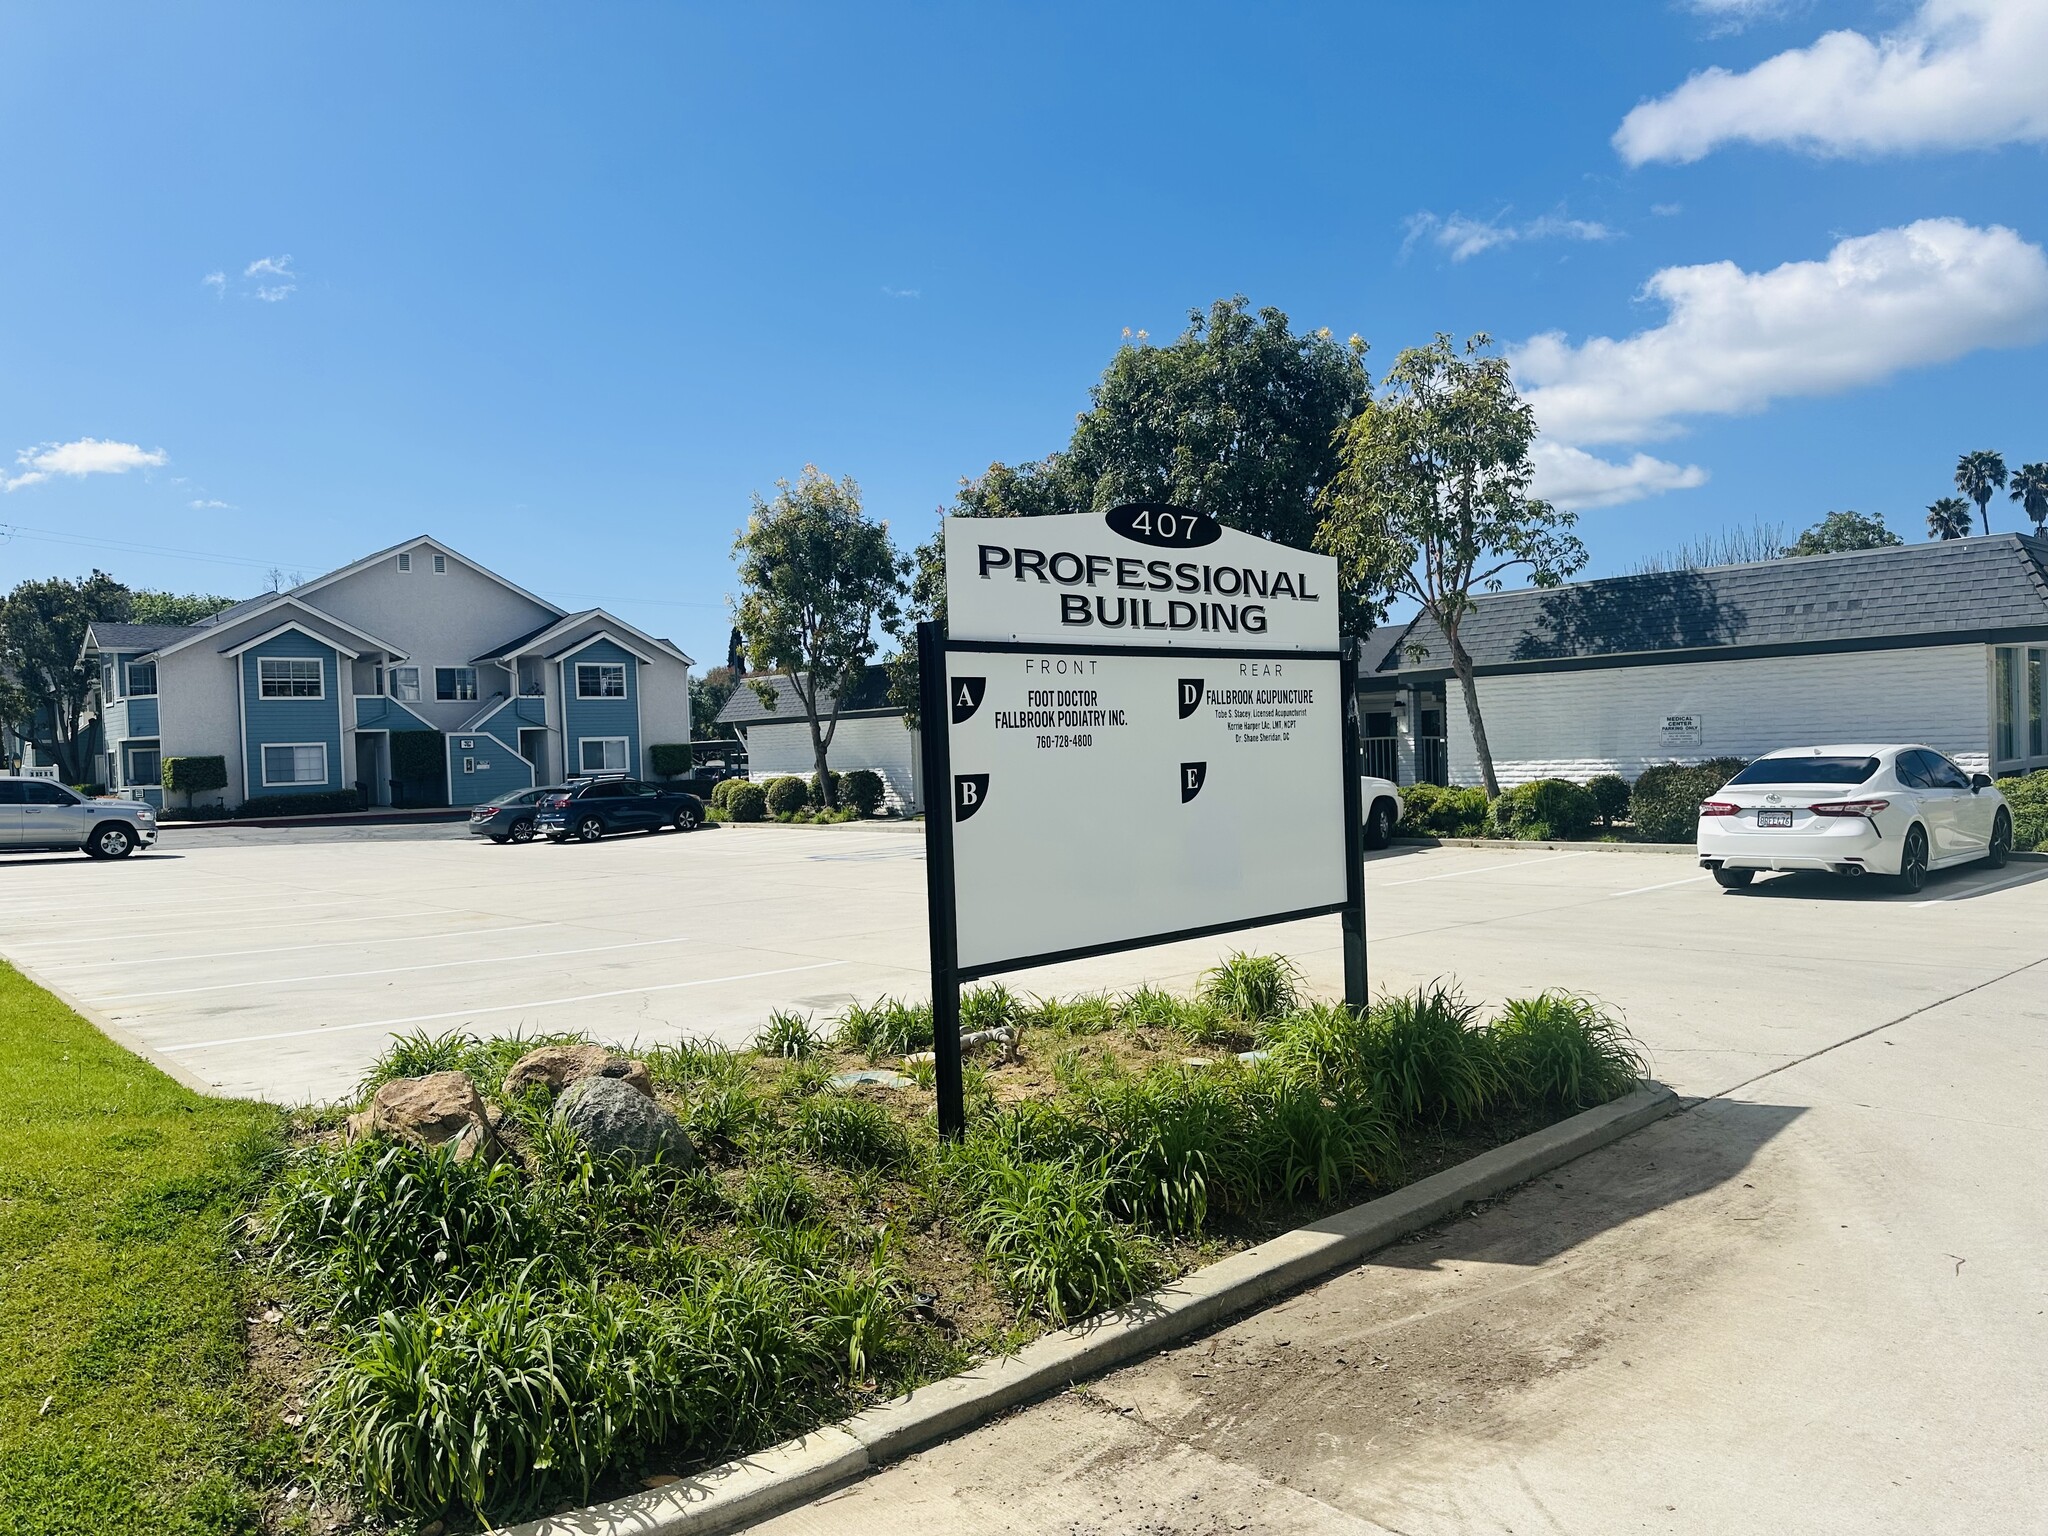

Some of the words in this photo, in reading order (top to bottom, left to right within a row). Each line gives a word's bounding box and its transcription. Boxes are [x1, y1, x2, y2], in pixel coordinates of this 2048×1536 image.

[1131, 510, 1199, 540] 407
[977, 544, 1320, 602] PROFESSIONAL
[1059, 593, 1268, 634] BUILDING
[1025, 659, 1098, 675] FRONT
[1239, 663, 1283, 677] REAR
[956, 683, 975, 707] A
[1028, 690, 1055, 708] FOOT
[1057, 690, 1098, 707] DOCTOR
[1183, 684, 1197, 705] D
[1206, 690, 1254, 705] FALLBROOK
[1256, 689, 1314, 704] ACUPUNCTURE
[994, 710, 1056, 729] FALLBROOK
[1057, 709, 1107, 728] PODIATRY
[1108, 709, 1128, 727] INC.
[1253, 709, 1274, 718] Licensed
[1275, 708, 1307, 719] Acupuncturist
[1036, 734, 1093, 749] 760-728-4800
[1186, 768, 1199, 790] E
[961, 781, 978, 806] B
